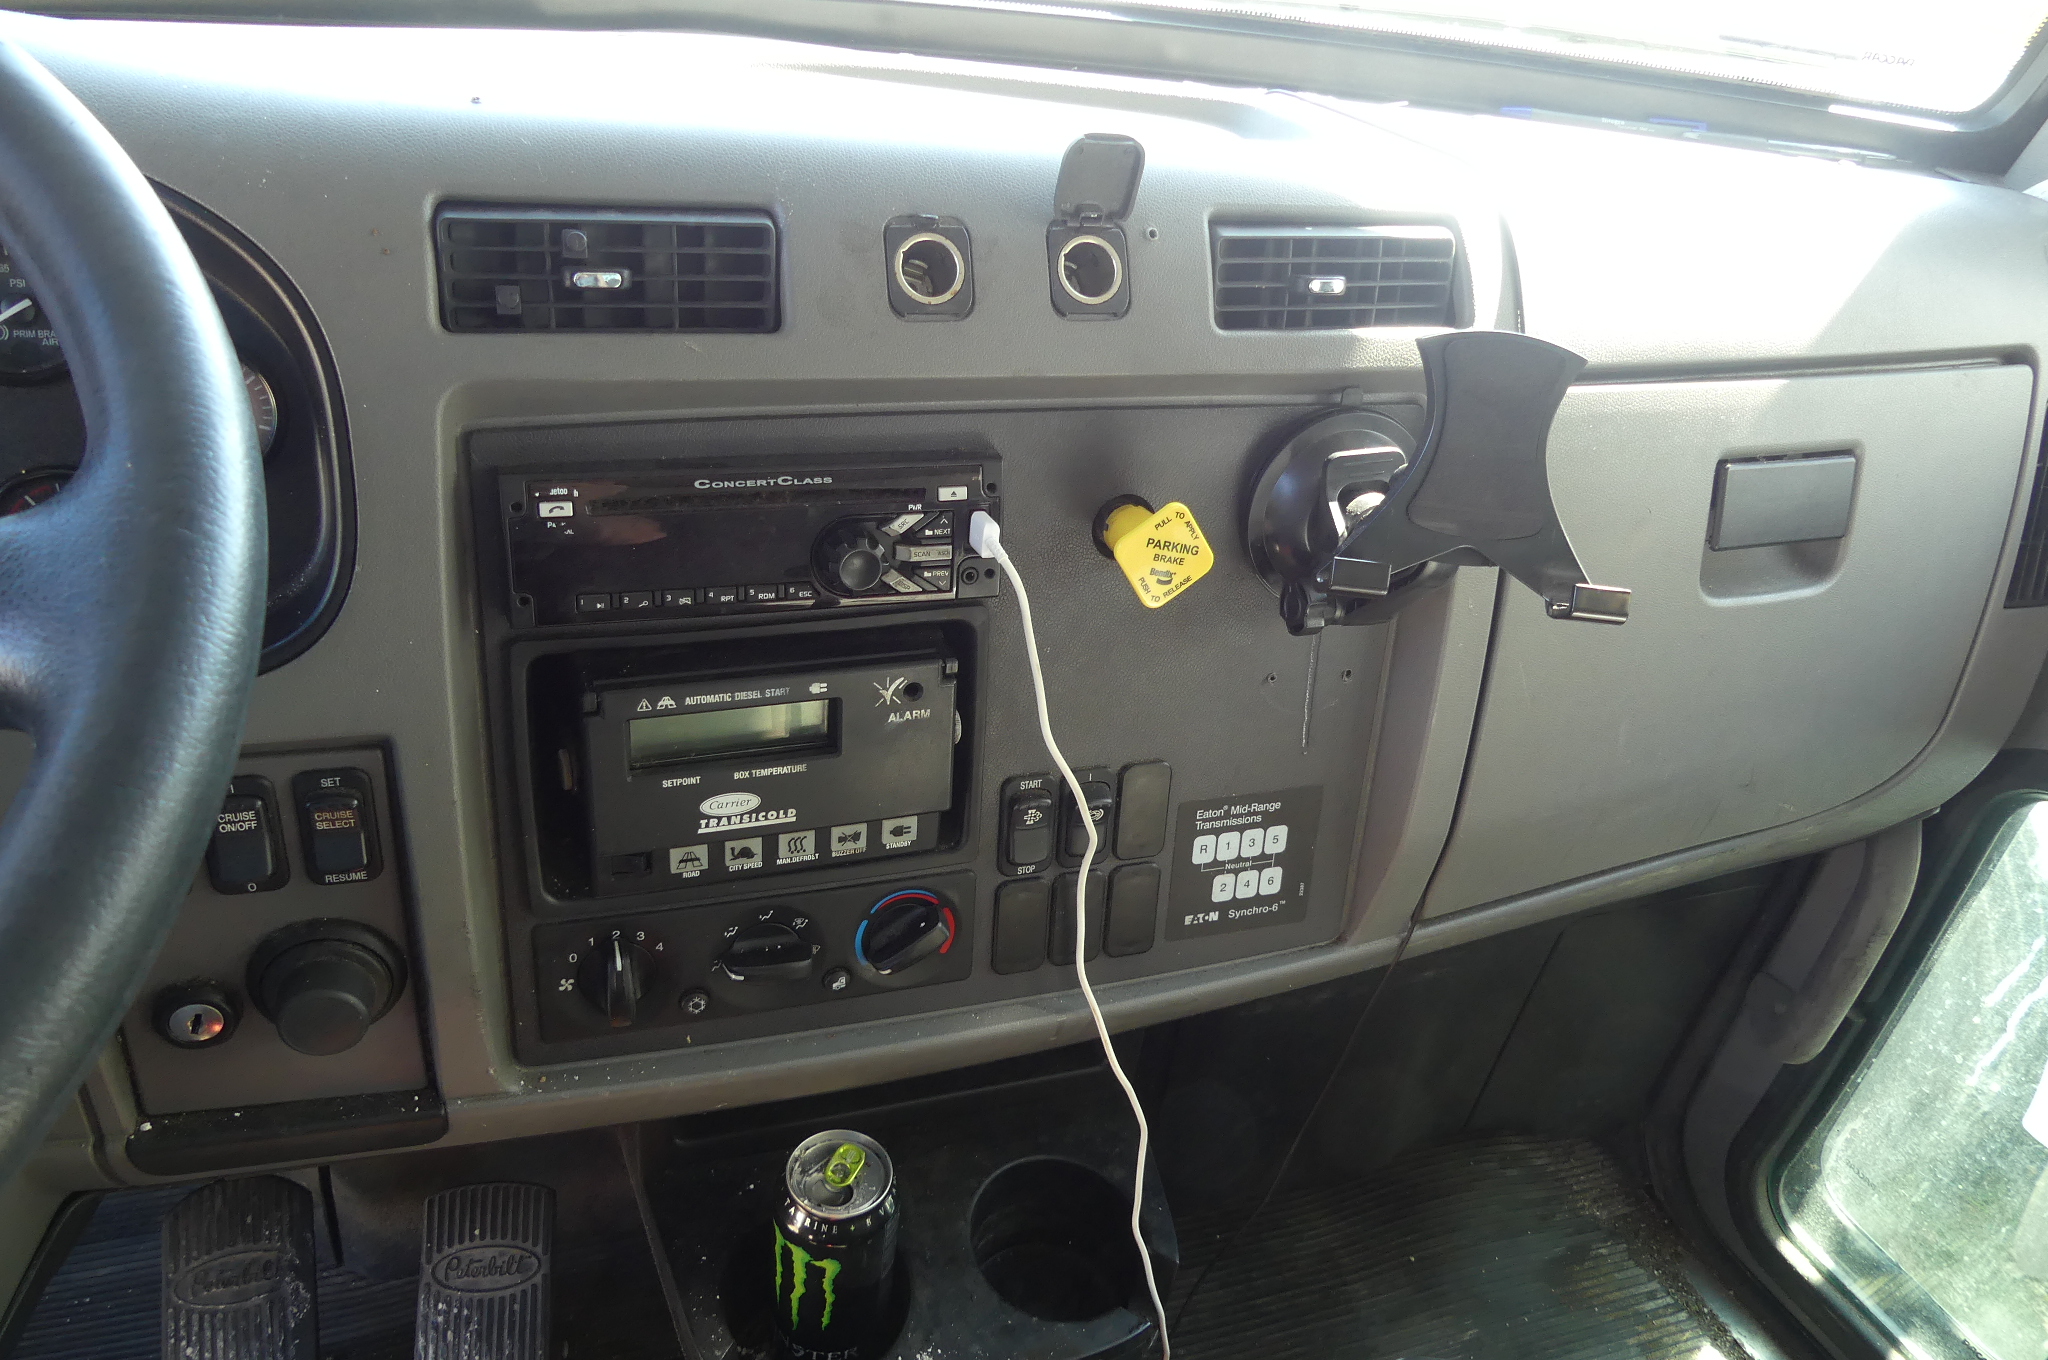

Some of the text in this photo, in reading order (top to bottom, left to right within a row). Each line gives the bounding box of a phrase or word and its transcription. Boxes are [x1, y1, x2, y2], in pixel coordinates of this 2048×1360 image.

[9, 278, 26, 288] PSI
[13, 329, 36, 338] PRIM
[908, 503, 923, 511] PWR
[897, 518, 910, 530] SRC
[1154, 511, 1200, 541] PULL TO APPLY
[934, 528, 951, 536] NEXT
[1146, 537, 1200, 556] PARKING
[1152, 553, 1186, 566] BRAKE
[798, 590, 813, 598] ESC
[1138, 575, 1193, 603] PUSH TO RELEASE
[758, 592, 776, 600] RDM
[580, 598, 585, 606] 1
[684, 686, 790, 706] AUTOMATIC DIESEL START
[887, 708, 931, 723] ALARM
[734, 763, 808, 780] BOX TEMPERATURE
[320, 777, 341, 788] SET
[662, 776, 702, 788] SETPOINT
[1019, 779, 1043, 790] START
[709, 797, 752, 811] Carrier
[1230, 801, 1282, 815] Mid-Range
[217, 811, 257, 823] CRUISE
[314, 810, 354, 822] CRUISE
[699, 808, 797, 829] TRANSICOLD
[219, 821, 258, 834] ON/OFF
[316, 819, 356, 830] SELECT
[1195, 814, 1262, 831] Transmissions
[885, 840, 912, 850] STANDBY
[1199, 834, 1279, 855] R 1 3 5
[831, 848, 855, 858] BUZZER
[728, 861, 763, 872] CITY SPEED
[1017, 865, 1036, 875] STOP
[1225, 860, 1253, 870] Neutral
[325, 871, 368, 884] RESUME
[682, 870, 700, 879] ROAD
[1219, 876, 1275, 893] 2 4 6
[612, 930, 621, 939] 2
[636, 931, 645, 941] 3
[588, 937, 594, 946] 1
[655, 942, 664, 951] 4
[569, 953, 578, 963] 0
[783, 1197, 838, 1235] TARINE
[443, 1252, 532, 1283] Peterbilt
